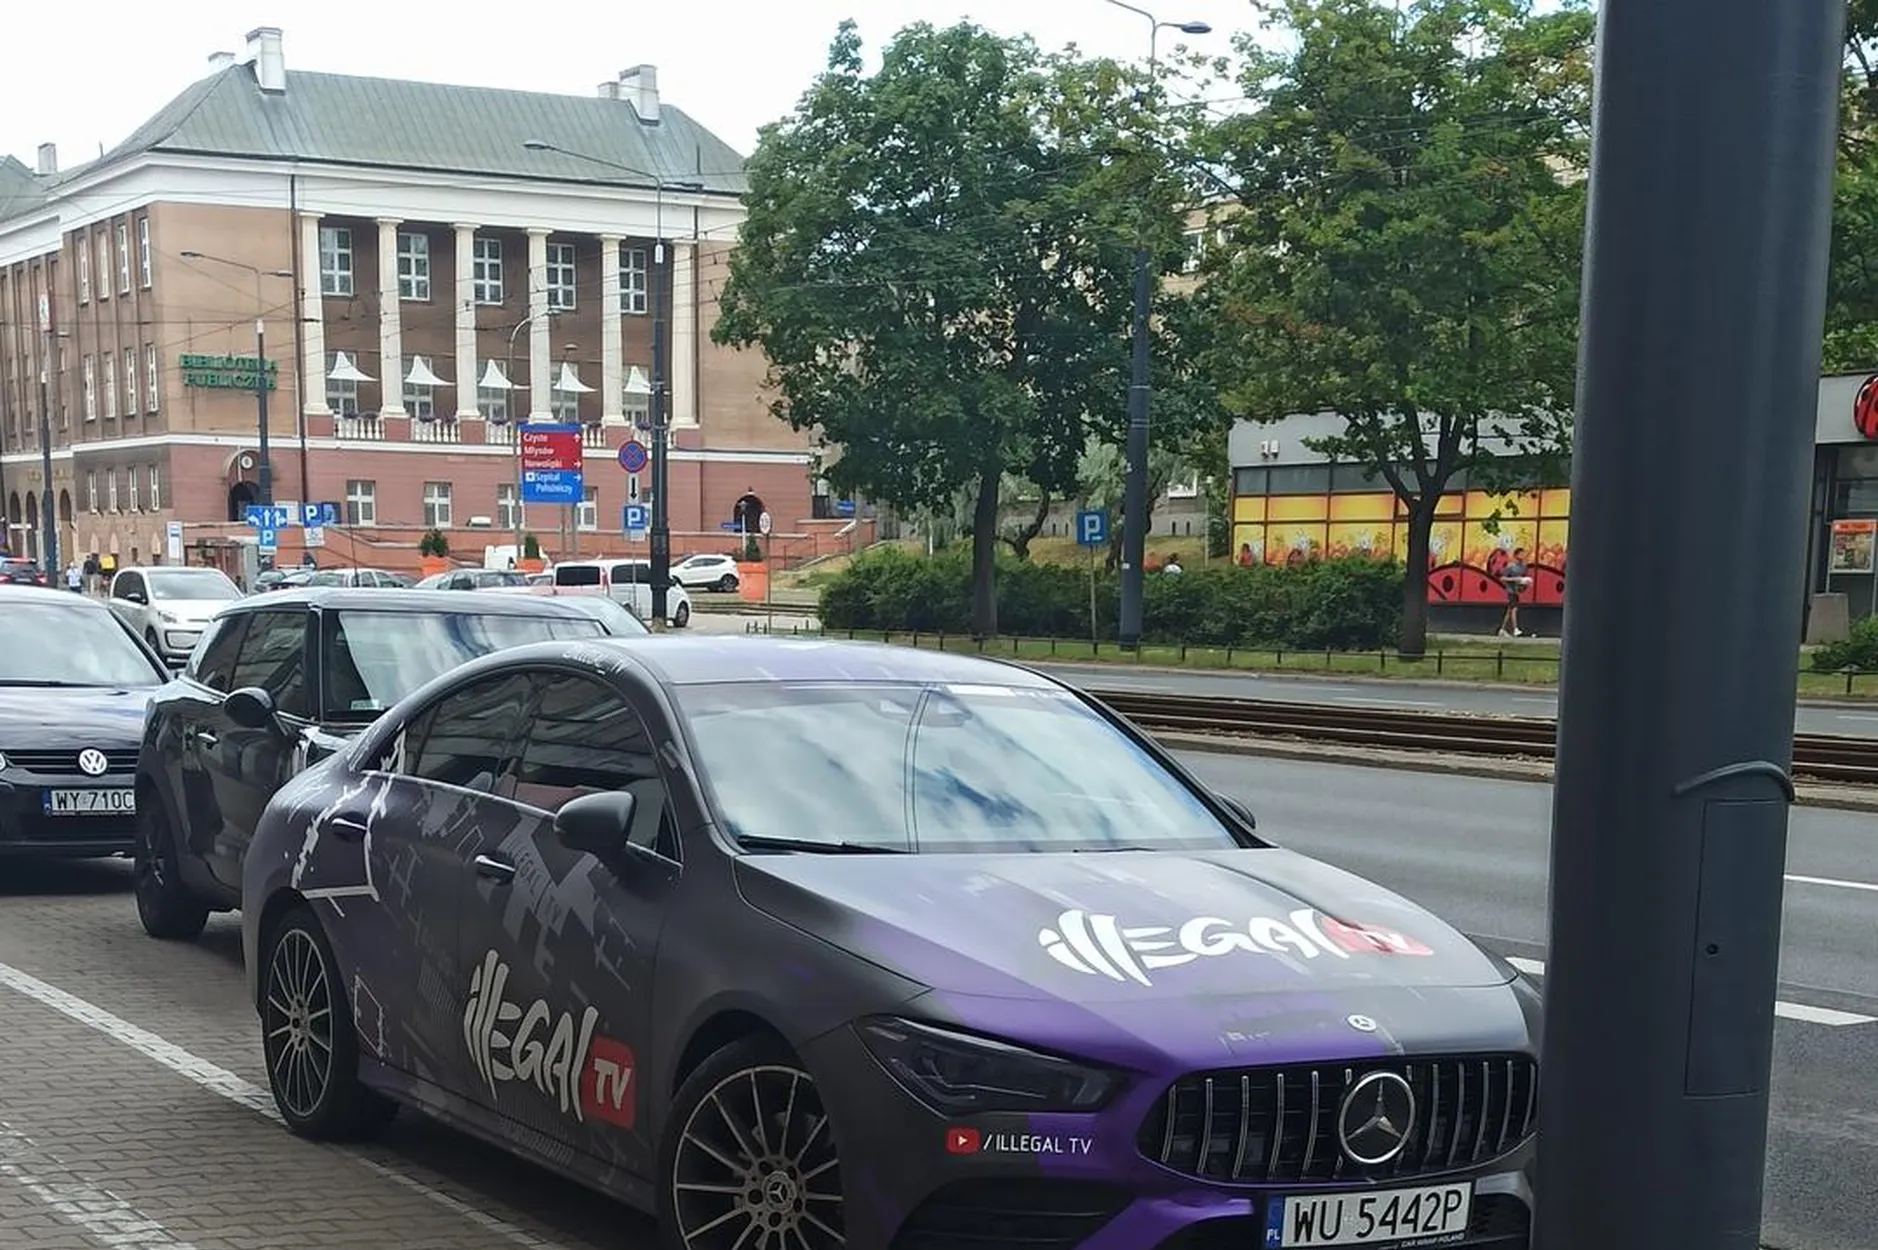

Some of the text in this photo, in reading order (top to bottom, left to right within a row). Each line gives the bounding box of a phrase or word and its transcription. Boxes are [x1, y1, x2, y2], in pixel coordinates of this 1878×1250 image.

[56, 792, 79, 809] WY
[594, 1058, 632, 1109] TV
[1069, 1137, 1092, 1154] TV
[1294, 1189, 1463, 1242] WU 5442P
[1266, 1229, 1281, 1241] PL
